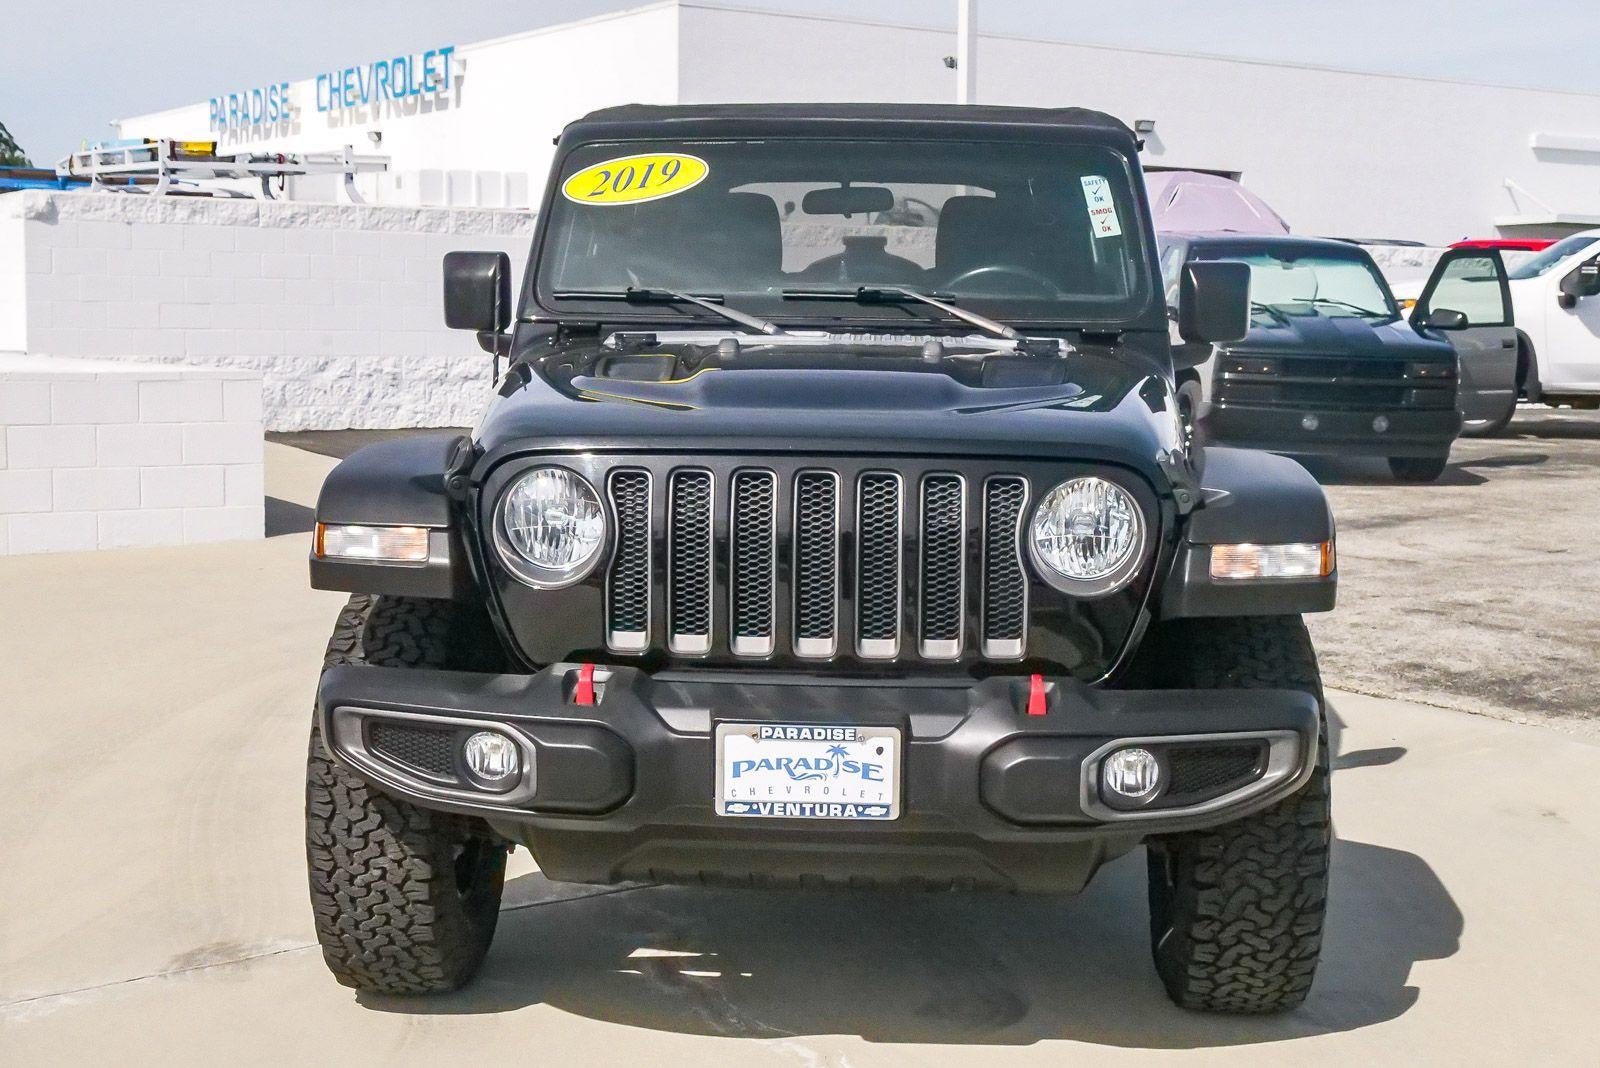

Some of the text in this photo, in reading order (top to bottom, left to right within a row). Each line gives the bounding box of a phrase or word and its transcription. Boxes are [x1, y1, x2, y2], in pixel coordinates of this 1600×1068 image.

[209, 46, 455, 127] PARADISE CHEVROLET
[587, 159, 681, 197] 2019
[1083, 178, 1106, 186] SAFETY
[1090, 208, 1112, 216] SMOG
[761, 727, 856, 741] PARADISE
[732, 744, 885, 782] PARADISE
[731, 786, 885, 801] CHEVROLET
[758, 802, 858, 818] VENTURA
